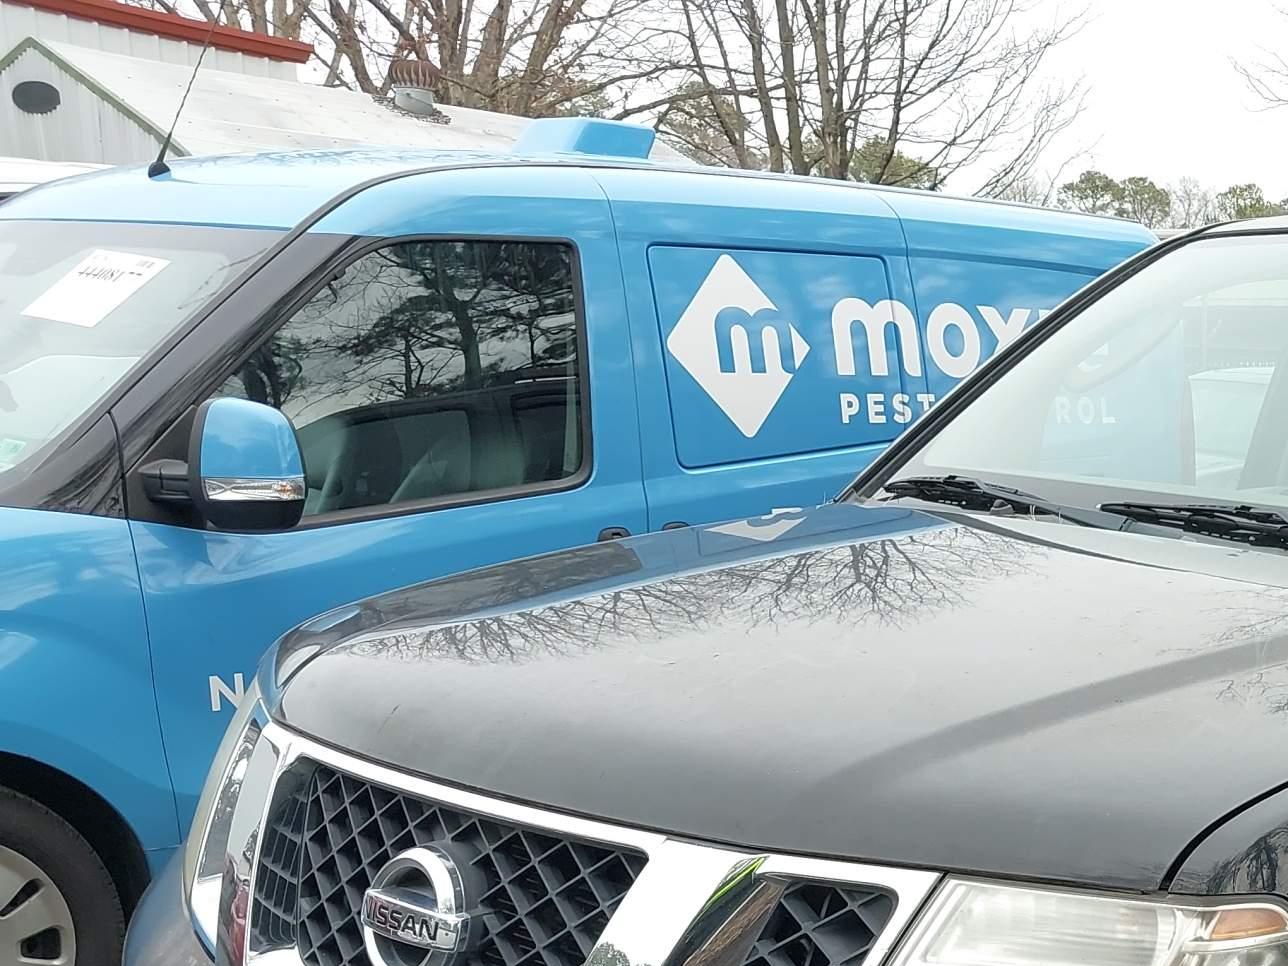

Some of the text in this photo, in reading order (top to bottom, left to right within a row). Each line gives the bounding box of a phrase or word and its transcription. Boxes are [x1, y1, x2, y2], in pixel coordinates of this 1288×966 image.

[831, 296, 1110, 378] mox
[839, 393, 1117, 424] PEST ROL
[366, 896, 439, 941] NISSAN
